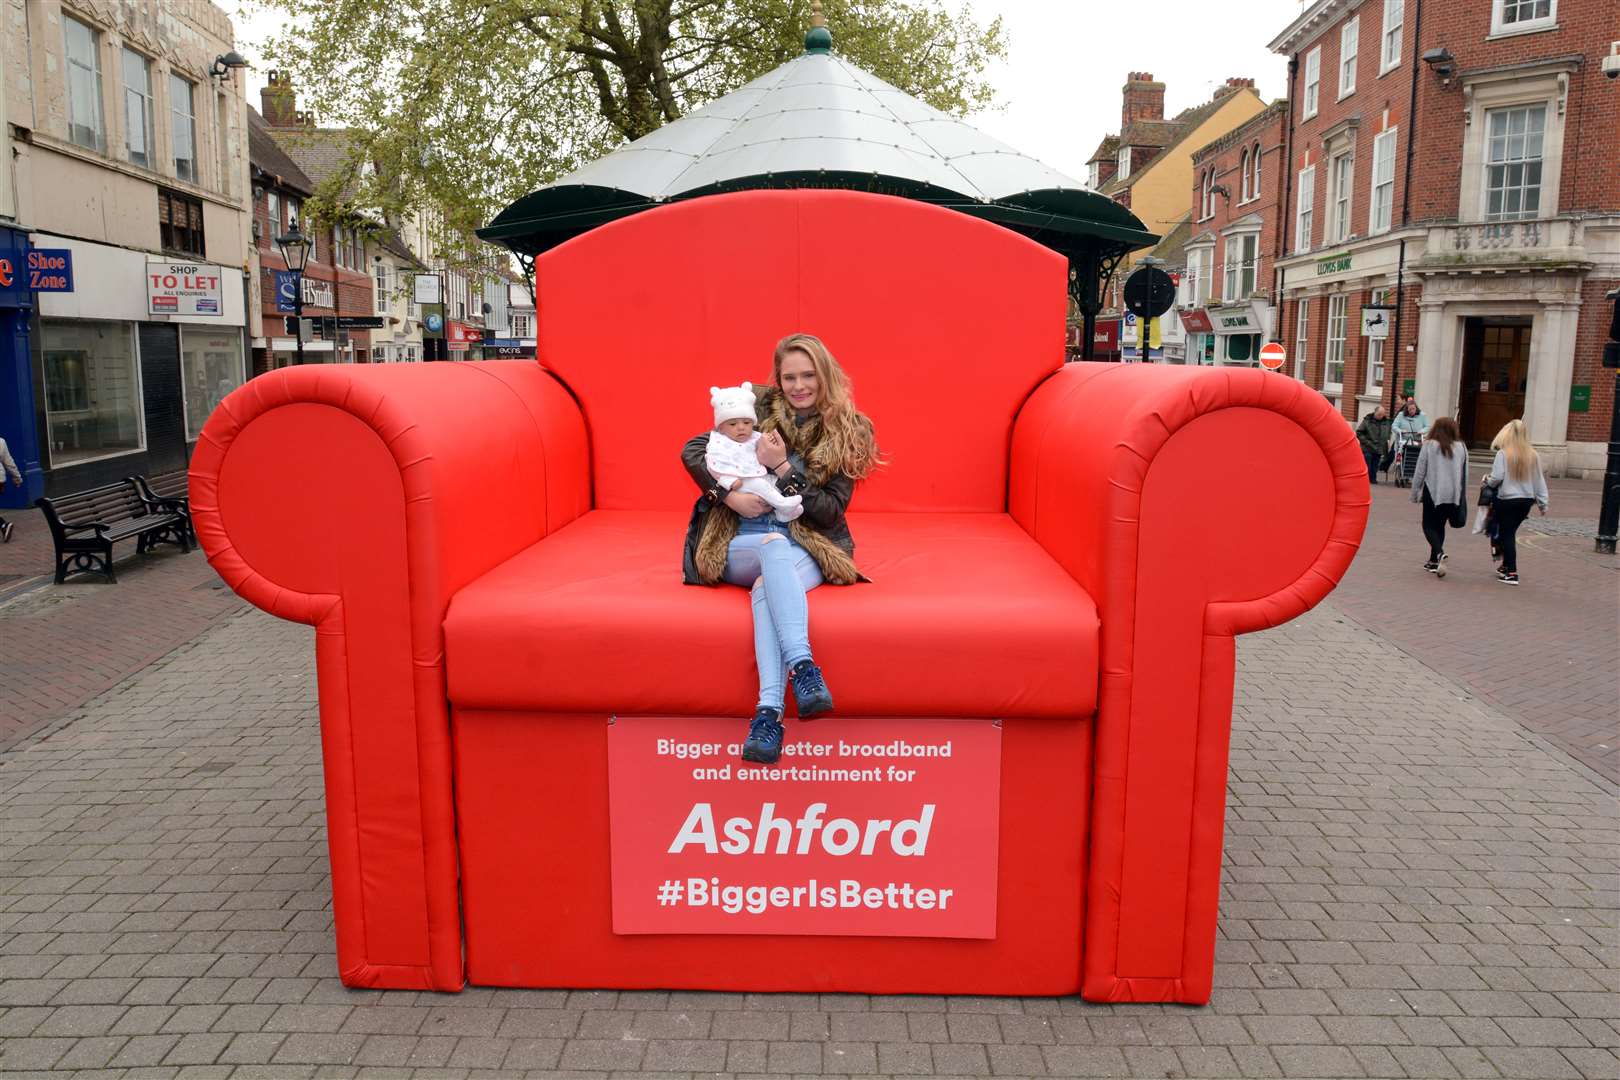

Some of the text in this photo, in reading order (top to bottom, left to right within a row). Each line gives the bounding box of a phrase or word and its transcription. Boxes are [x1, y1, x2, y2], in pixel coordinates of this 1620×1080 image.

[28, 252, 65, 269] Shoe
[1317, 256, 1353, 275] LLOYDS BANK
[170, 266, 198, 274] SHOP
[30, 271, 67, 288] Zone
[150, 274, 218, 289] TO LET
[657, 739, 722, 759] Bigger
[780, 741, 833, 757] etter
[839, 740, 952, 758] broadband
[692, 765, 916, 782] and entertainment for
[667, 802, 936, 857] Ashford
[656, 876, 954, 914] #BiggerIsBetter
